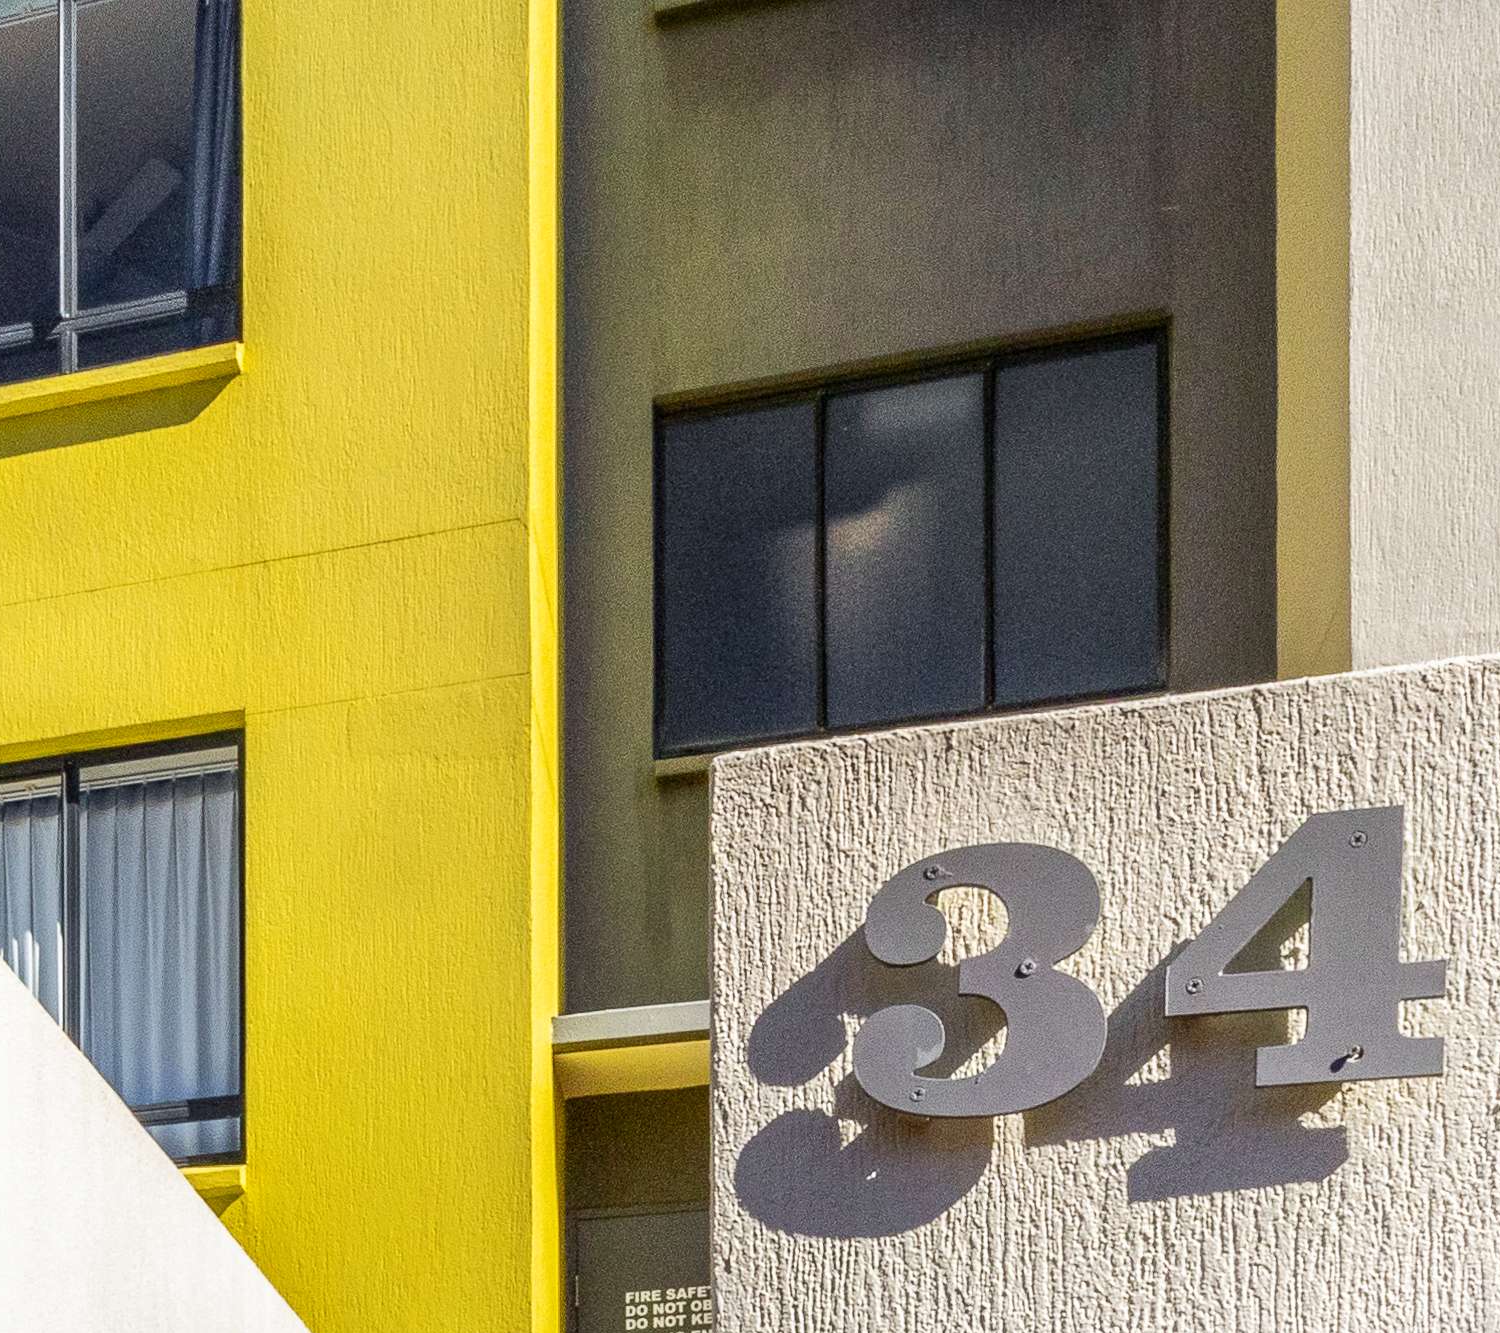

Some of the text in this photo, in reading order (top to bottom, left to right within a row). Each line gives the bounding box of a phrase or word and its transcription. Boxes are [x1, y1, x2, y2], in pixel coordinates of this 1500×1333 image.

[853, 805, 1449, 1117] 34
[625, 1290, 662, 1304] FIRE
[625, 1305, 648, 1317] DO
[653, 1302, 687, 1316] NOT
[625, 1319, 648, 1331] DO
[653, 1315, 687, 1328] NOT
